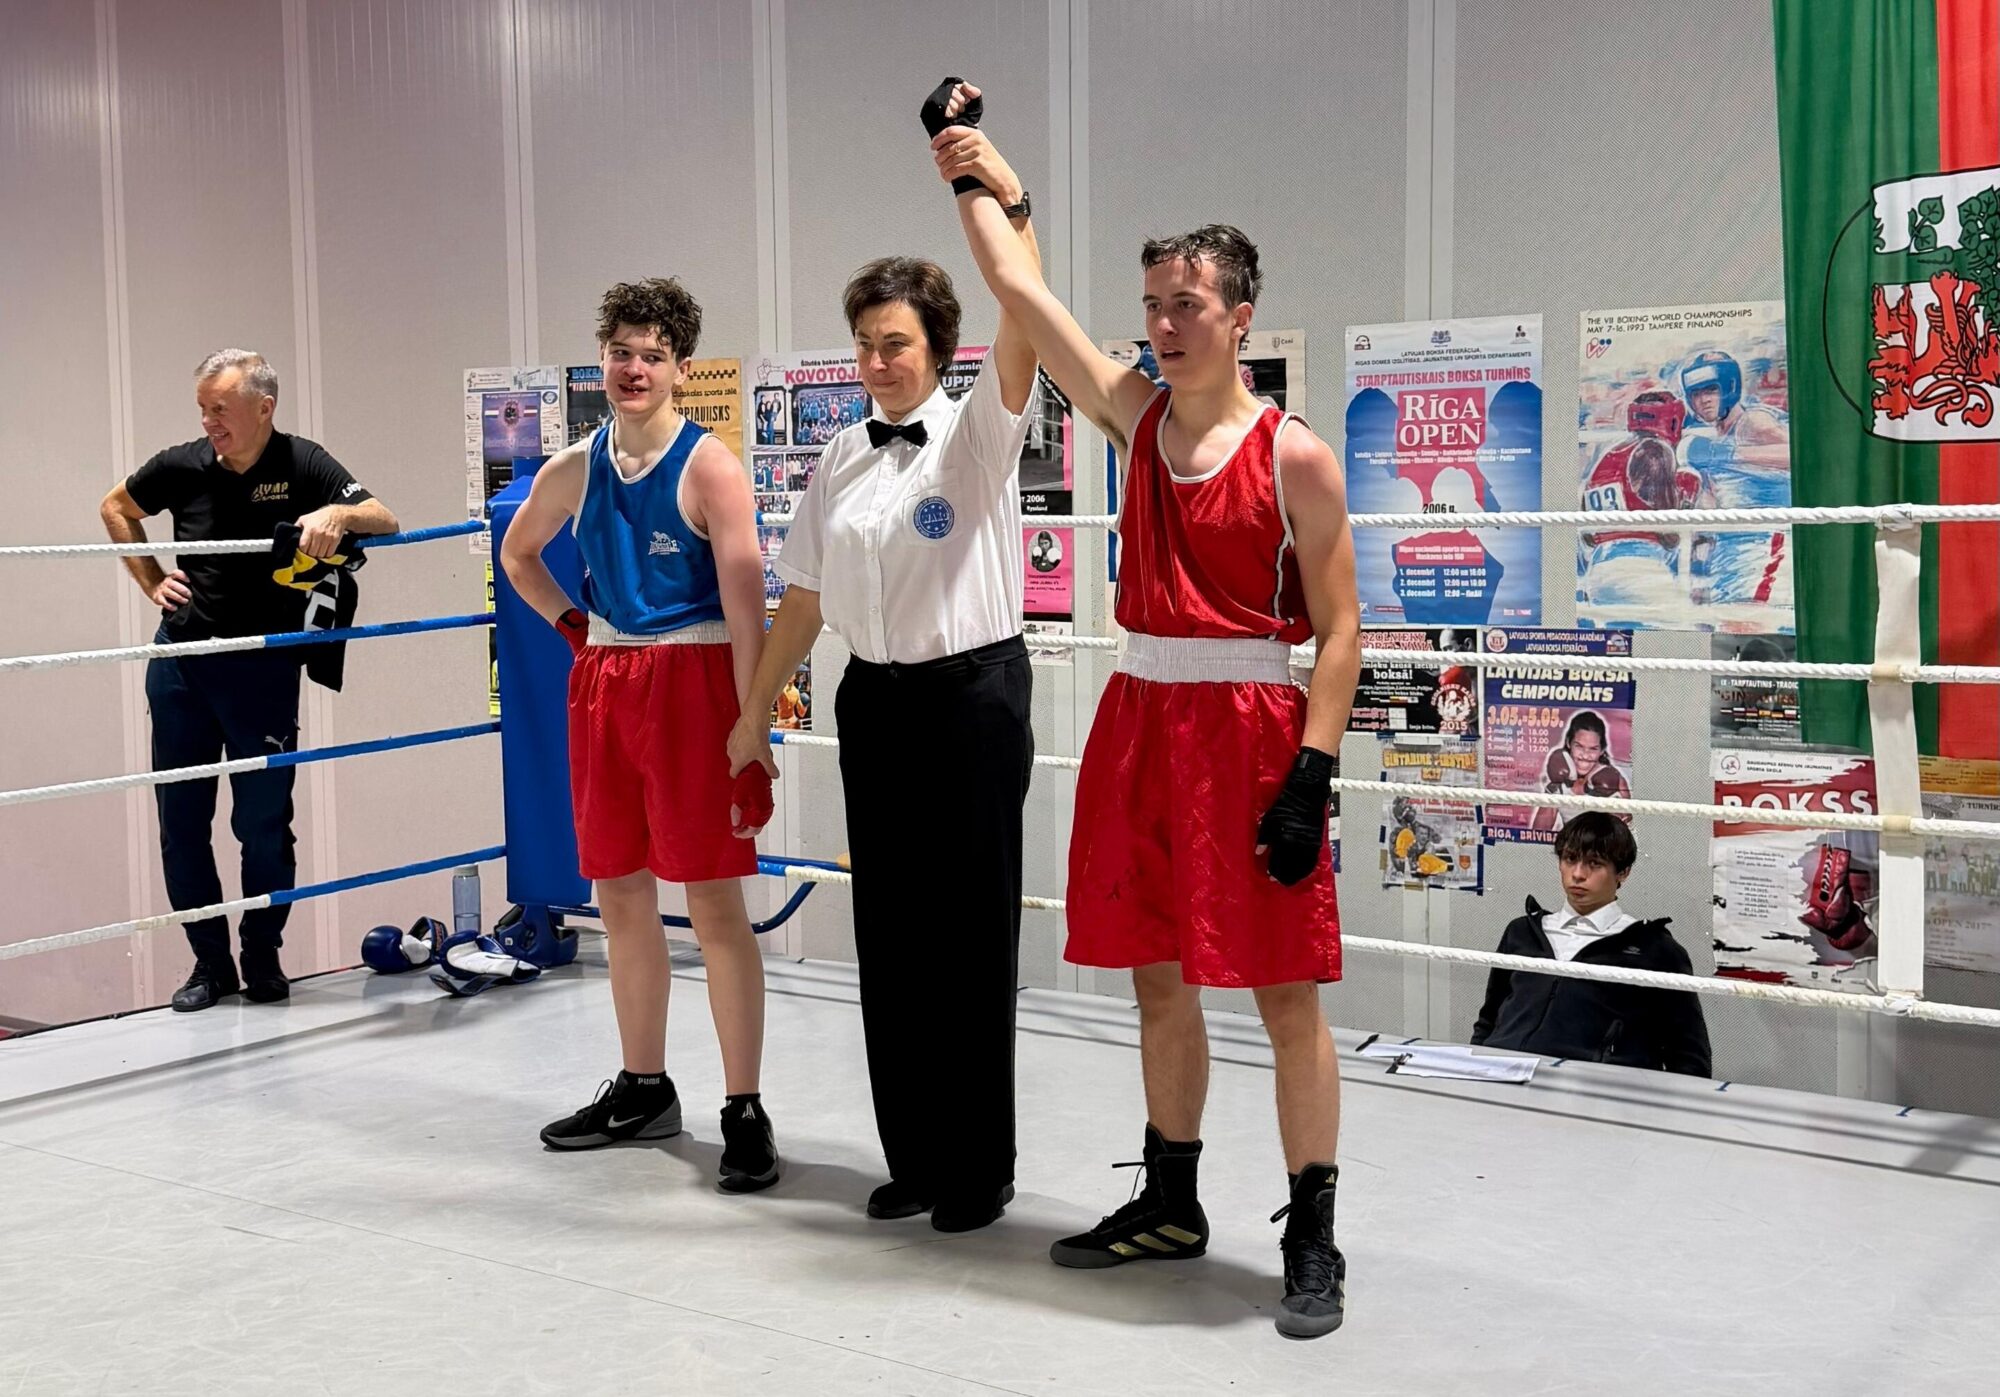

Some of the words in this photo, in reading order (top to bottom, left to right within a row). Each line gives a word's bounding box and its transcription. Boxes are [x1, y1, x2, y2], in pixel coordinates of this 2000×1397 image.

[1587, 317, 1600, 325] THE
[1617, 315, 1648, 323] BOXING
[1651, 313, 1681, 321] WORLD
[1684, 309, 1753, 320] CHAMPIONSHIPS
[1587, 326, 1604, 334] MAY
[1626, 323, 1645, 332] 1993
[1649, 322, 1684, 331] TAMPERE
[1687, 320, 1724, 329] FINLAND
[942, 375, 978, 388] UPP
[1355, 371, 1446, 387] STARPTAUTISKAIS
[1447, 369, 1483, 383] BOKSA
[1484, 366, 1531, 381] TURNĪRS
[1402, 393, 1481, 422] RĪGA
[1400, 422, 1483, 447] OPEN
[1026, 494, 1046, 503] 2006
[1422, 503, 1447, 514] 2006
[1373, 668, 1413, 679] boksā!
[1486, 665, 1564, 680] LATVIJAS
[1568, 667, 1630, 682] BOKSA
[1501, 680, 1614, 703] ČEMPIONĀTS
[1440, 720, 1468, 731] 2015
[1528, 737, 1549, 745] 12.00
[1528, 745, 1549, 753] 12.00
[1487, 826, 1515, 840] RĪGA,
